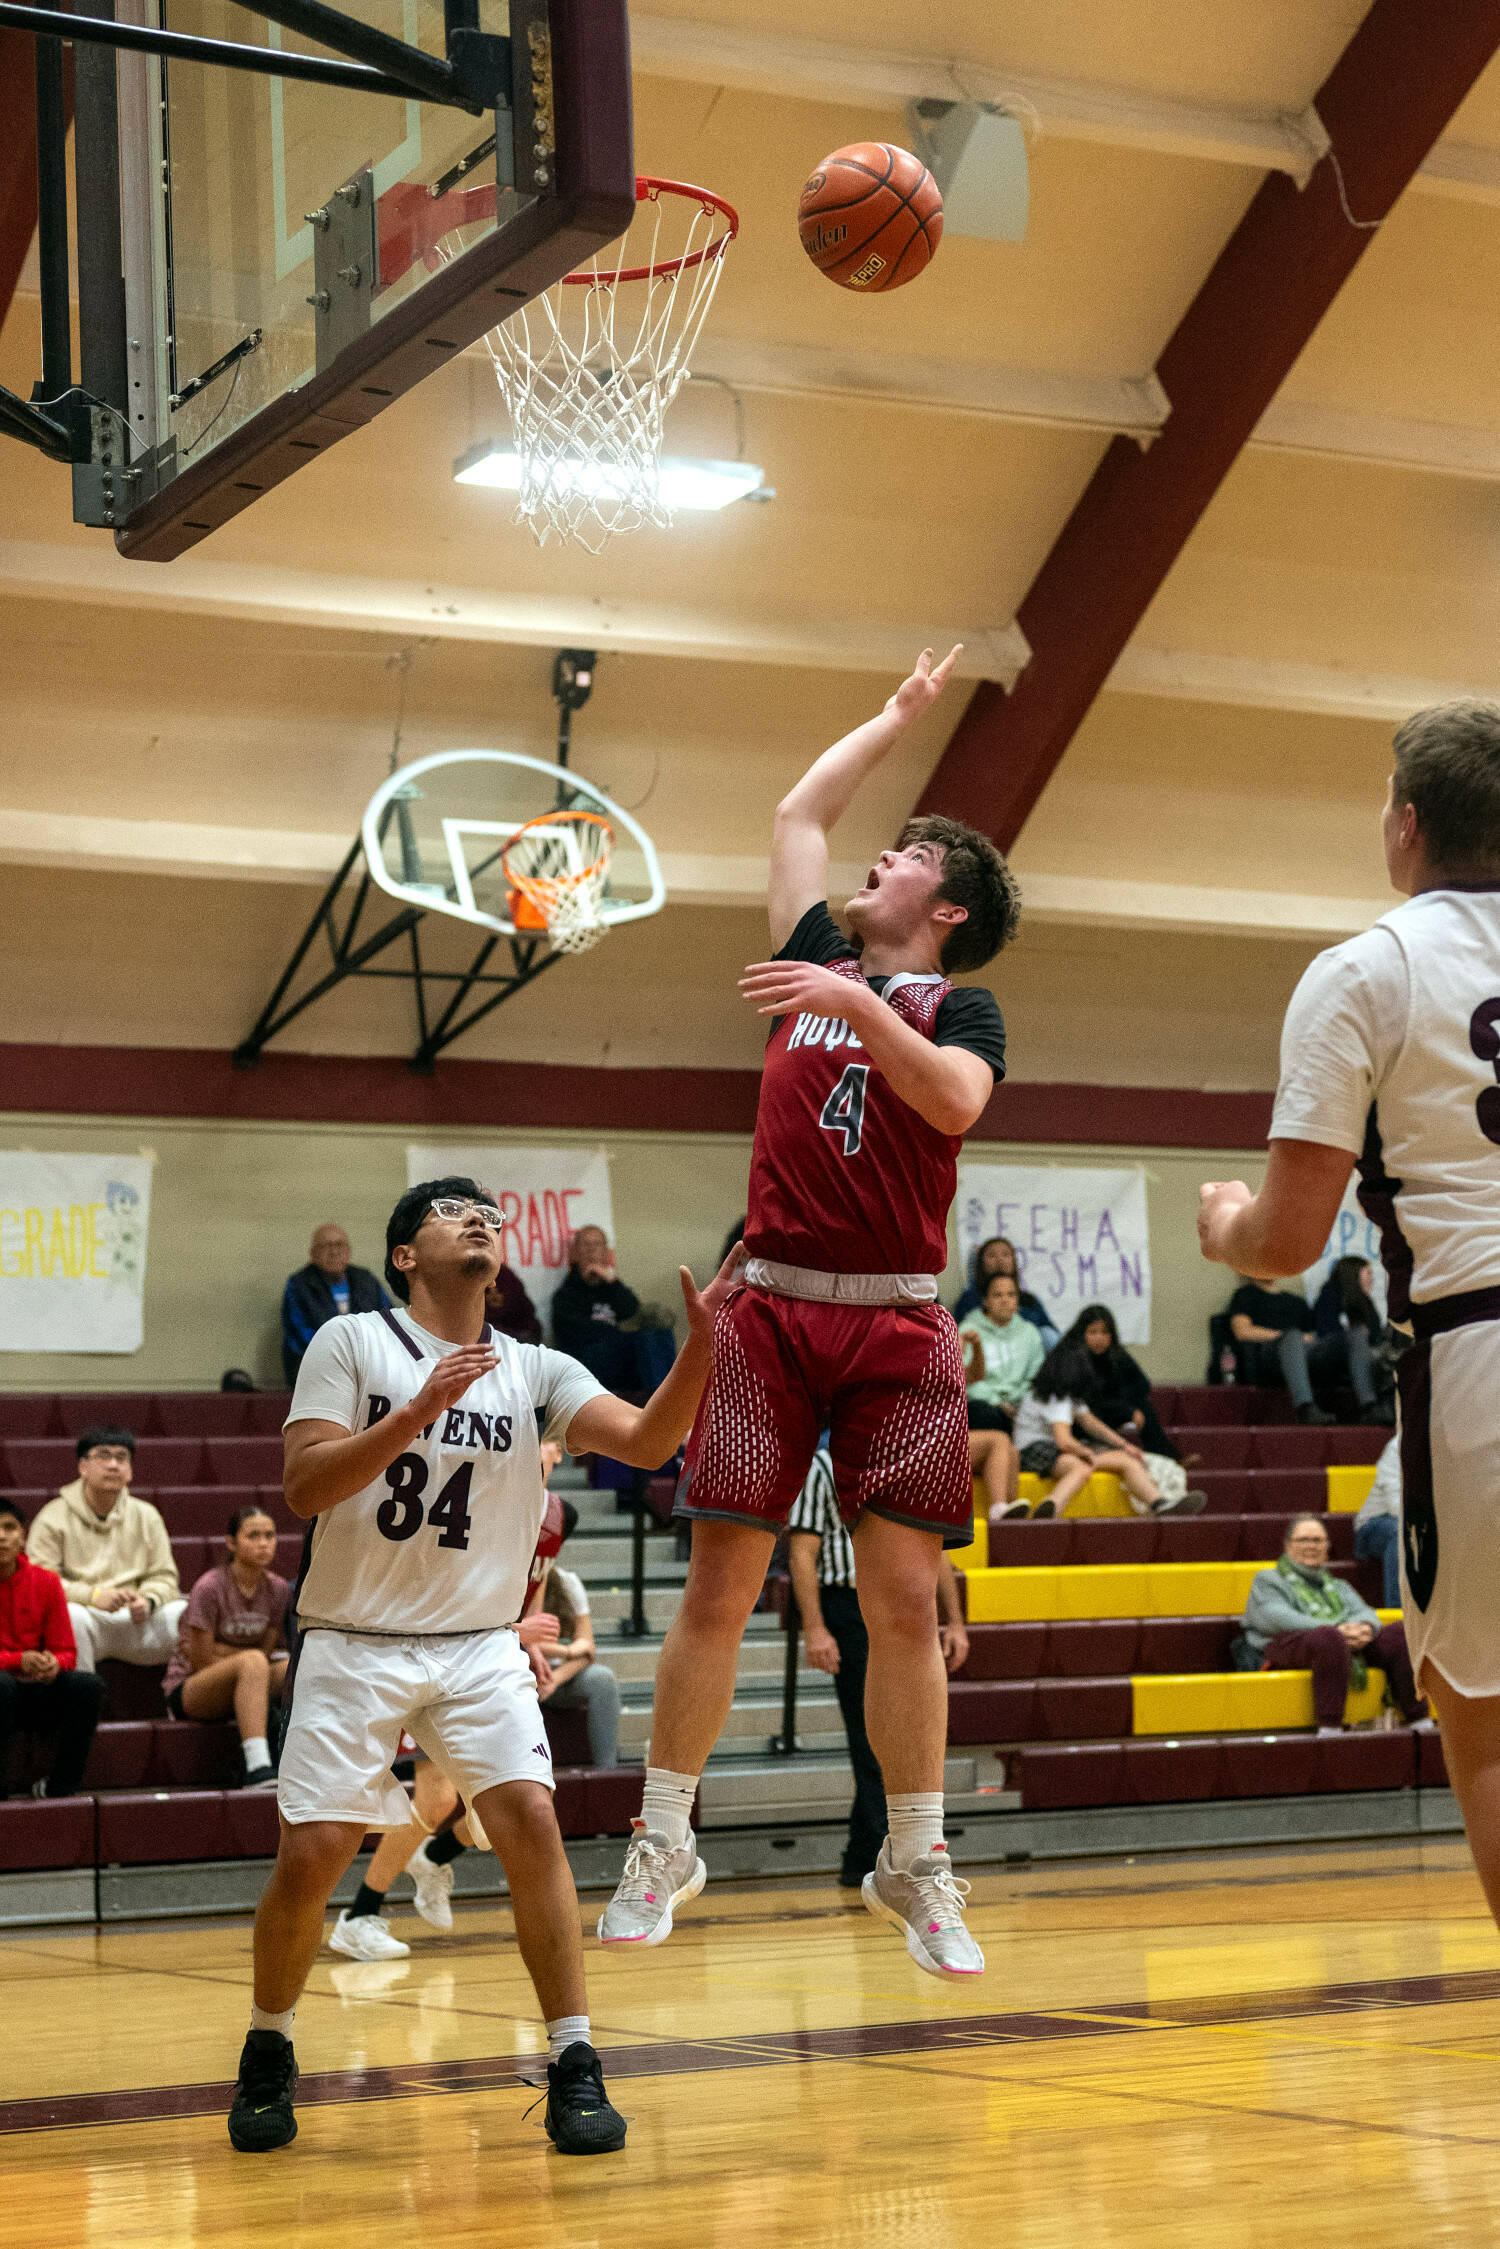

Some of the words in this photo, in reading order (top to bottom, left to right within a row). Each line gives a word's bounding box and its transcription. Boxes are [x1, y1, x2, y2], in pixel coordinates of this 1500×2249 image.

[857, 256, 882, 282] PRO
[819, 1063, 870, 1156] 4
[0, 1203, 110, 1278] GRADE
[488, 1189, 584, 1268] RADE
[376, 1452, 475, 1551] 34
